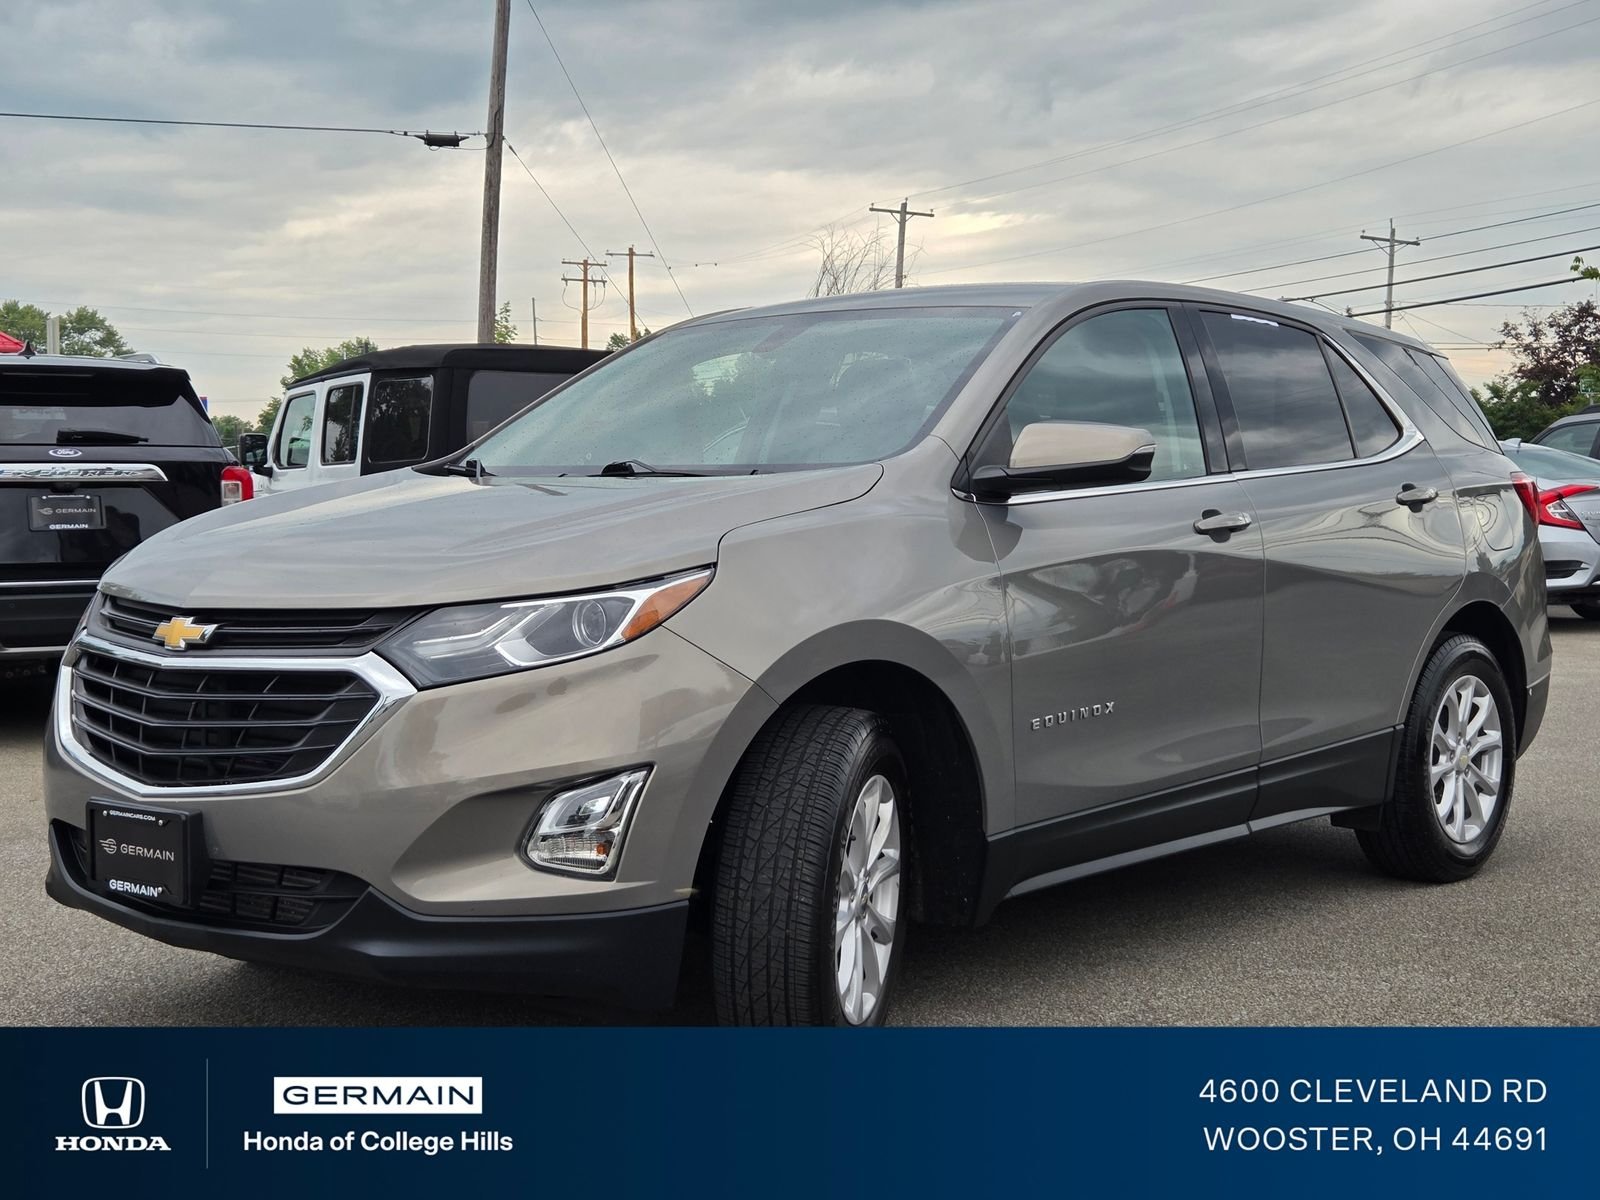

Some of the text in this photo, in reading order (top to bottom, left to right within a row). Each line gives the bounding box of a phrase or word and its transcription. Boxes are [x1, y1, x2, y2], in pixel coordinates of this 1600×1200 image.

[1031, 701, 1115, 731] EQUINOX
[120, 843, 175, 861] GERMAIN
[109, 879, 158, 897] GERMAIN
